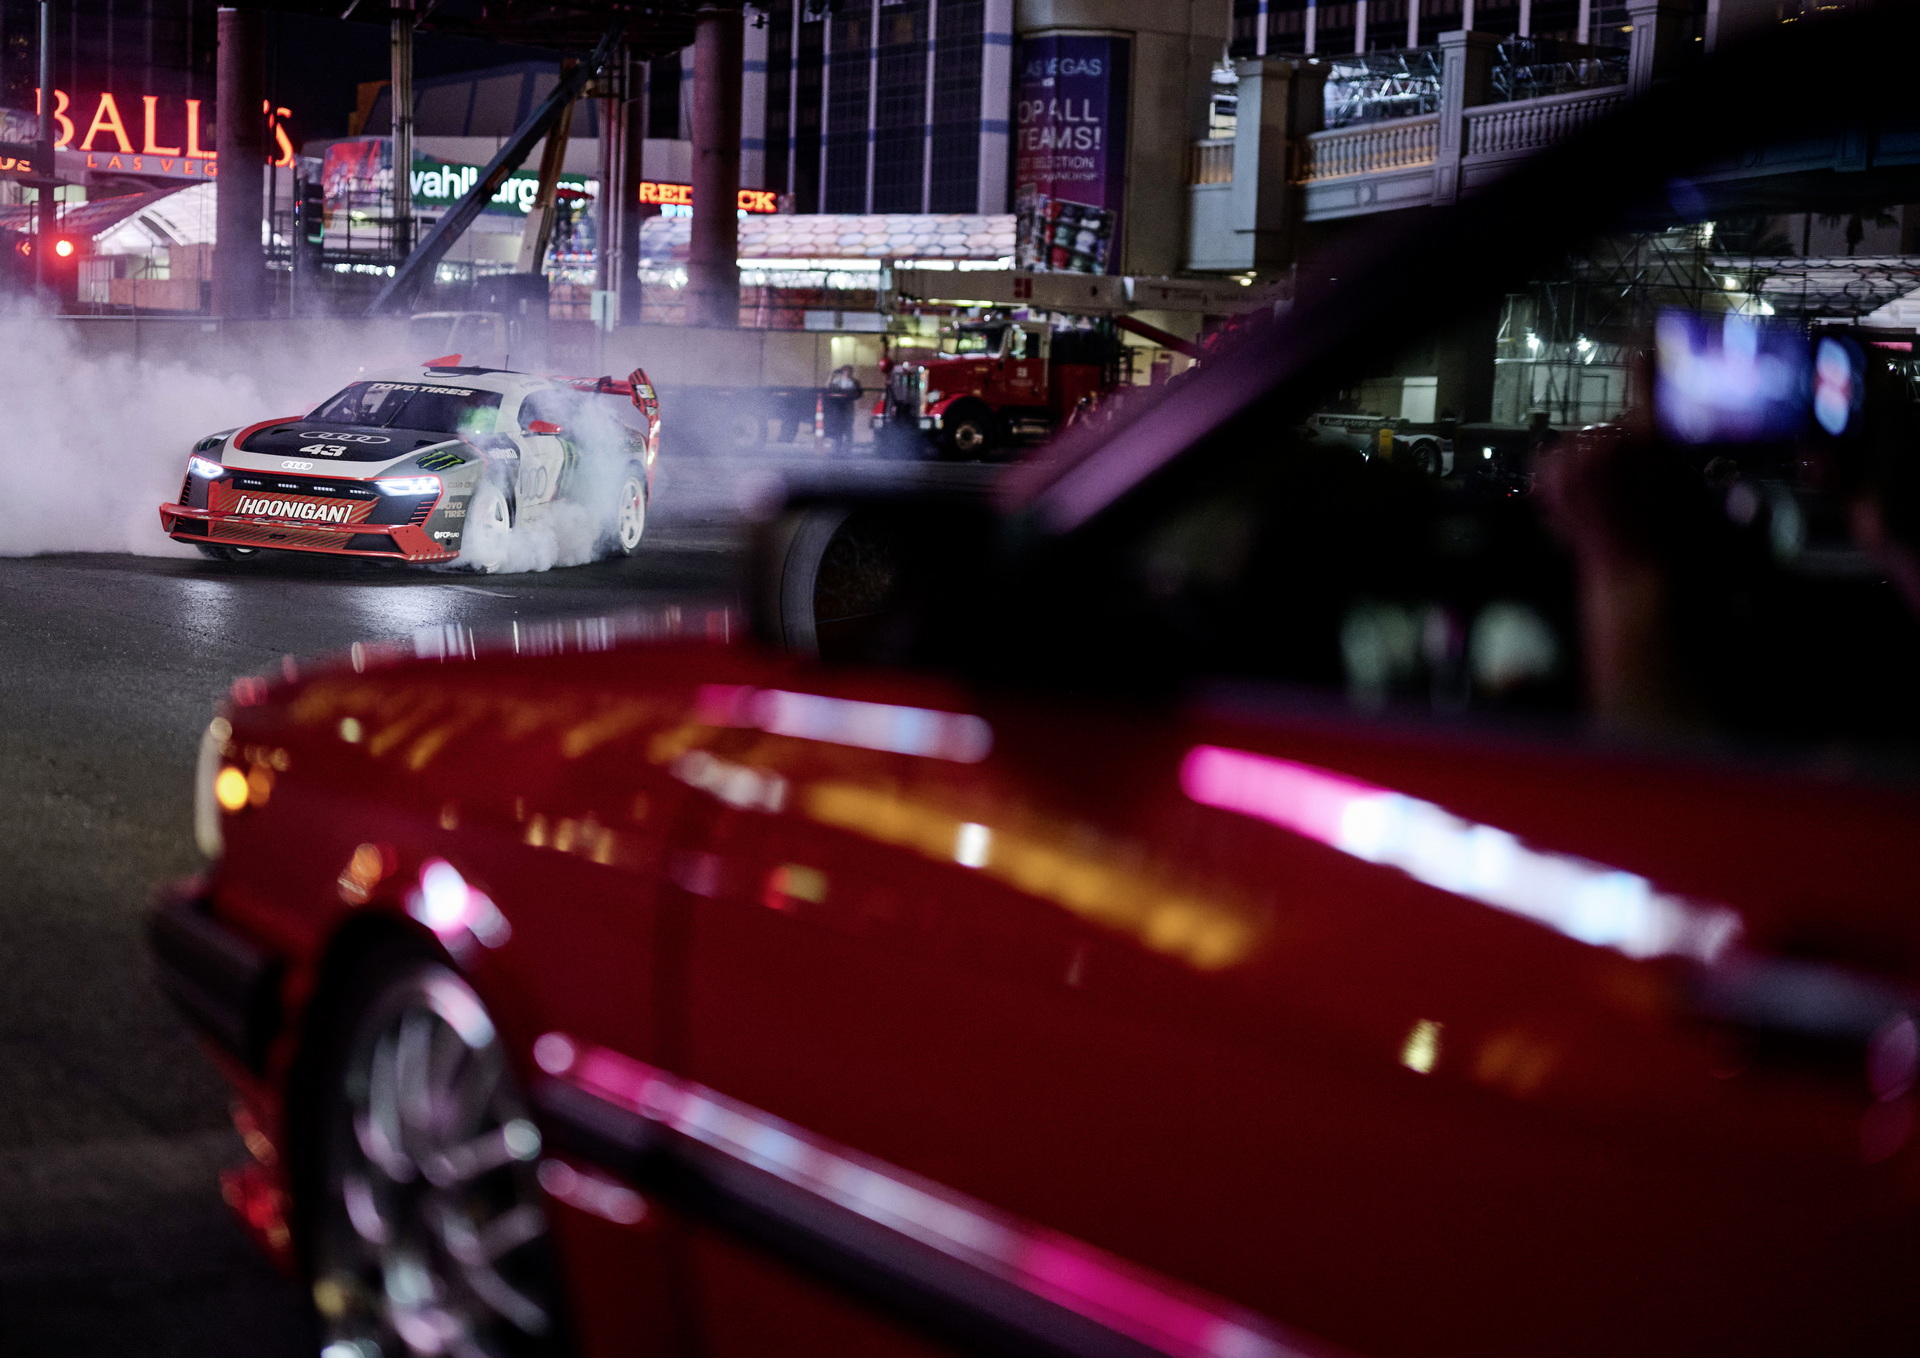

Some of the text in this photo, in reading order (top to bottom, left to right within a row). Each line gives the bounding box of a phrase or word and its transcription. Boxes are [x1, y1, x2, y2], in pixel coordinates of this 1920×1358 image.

[1048, 97, 1100, 123] ALL
[87, 153, 143, 171] LAS
[366, 382, 473, 397] TOYO TIRES
[299, 443, 348, 457] 43
[444, 509, 467, 518] TIRES
